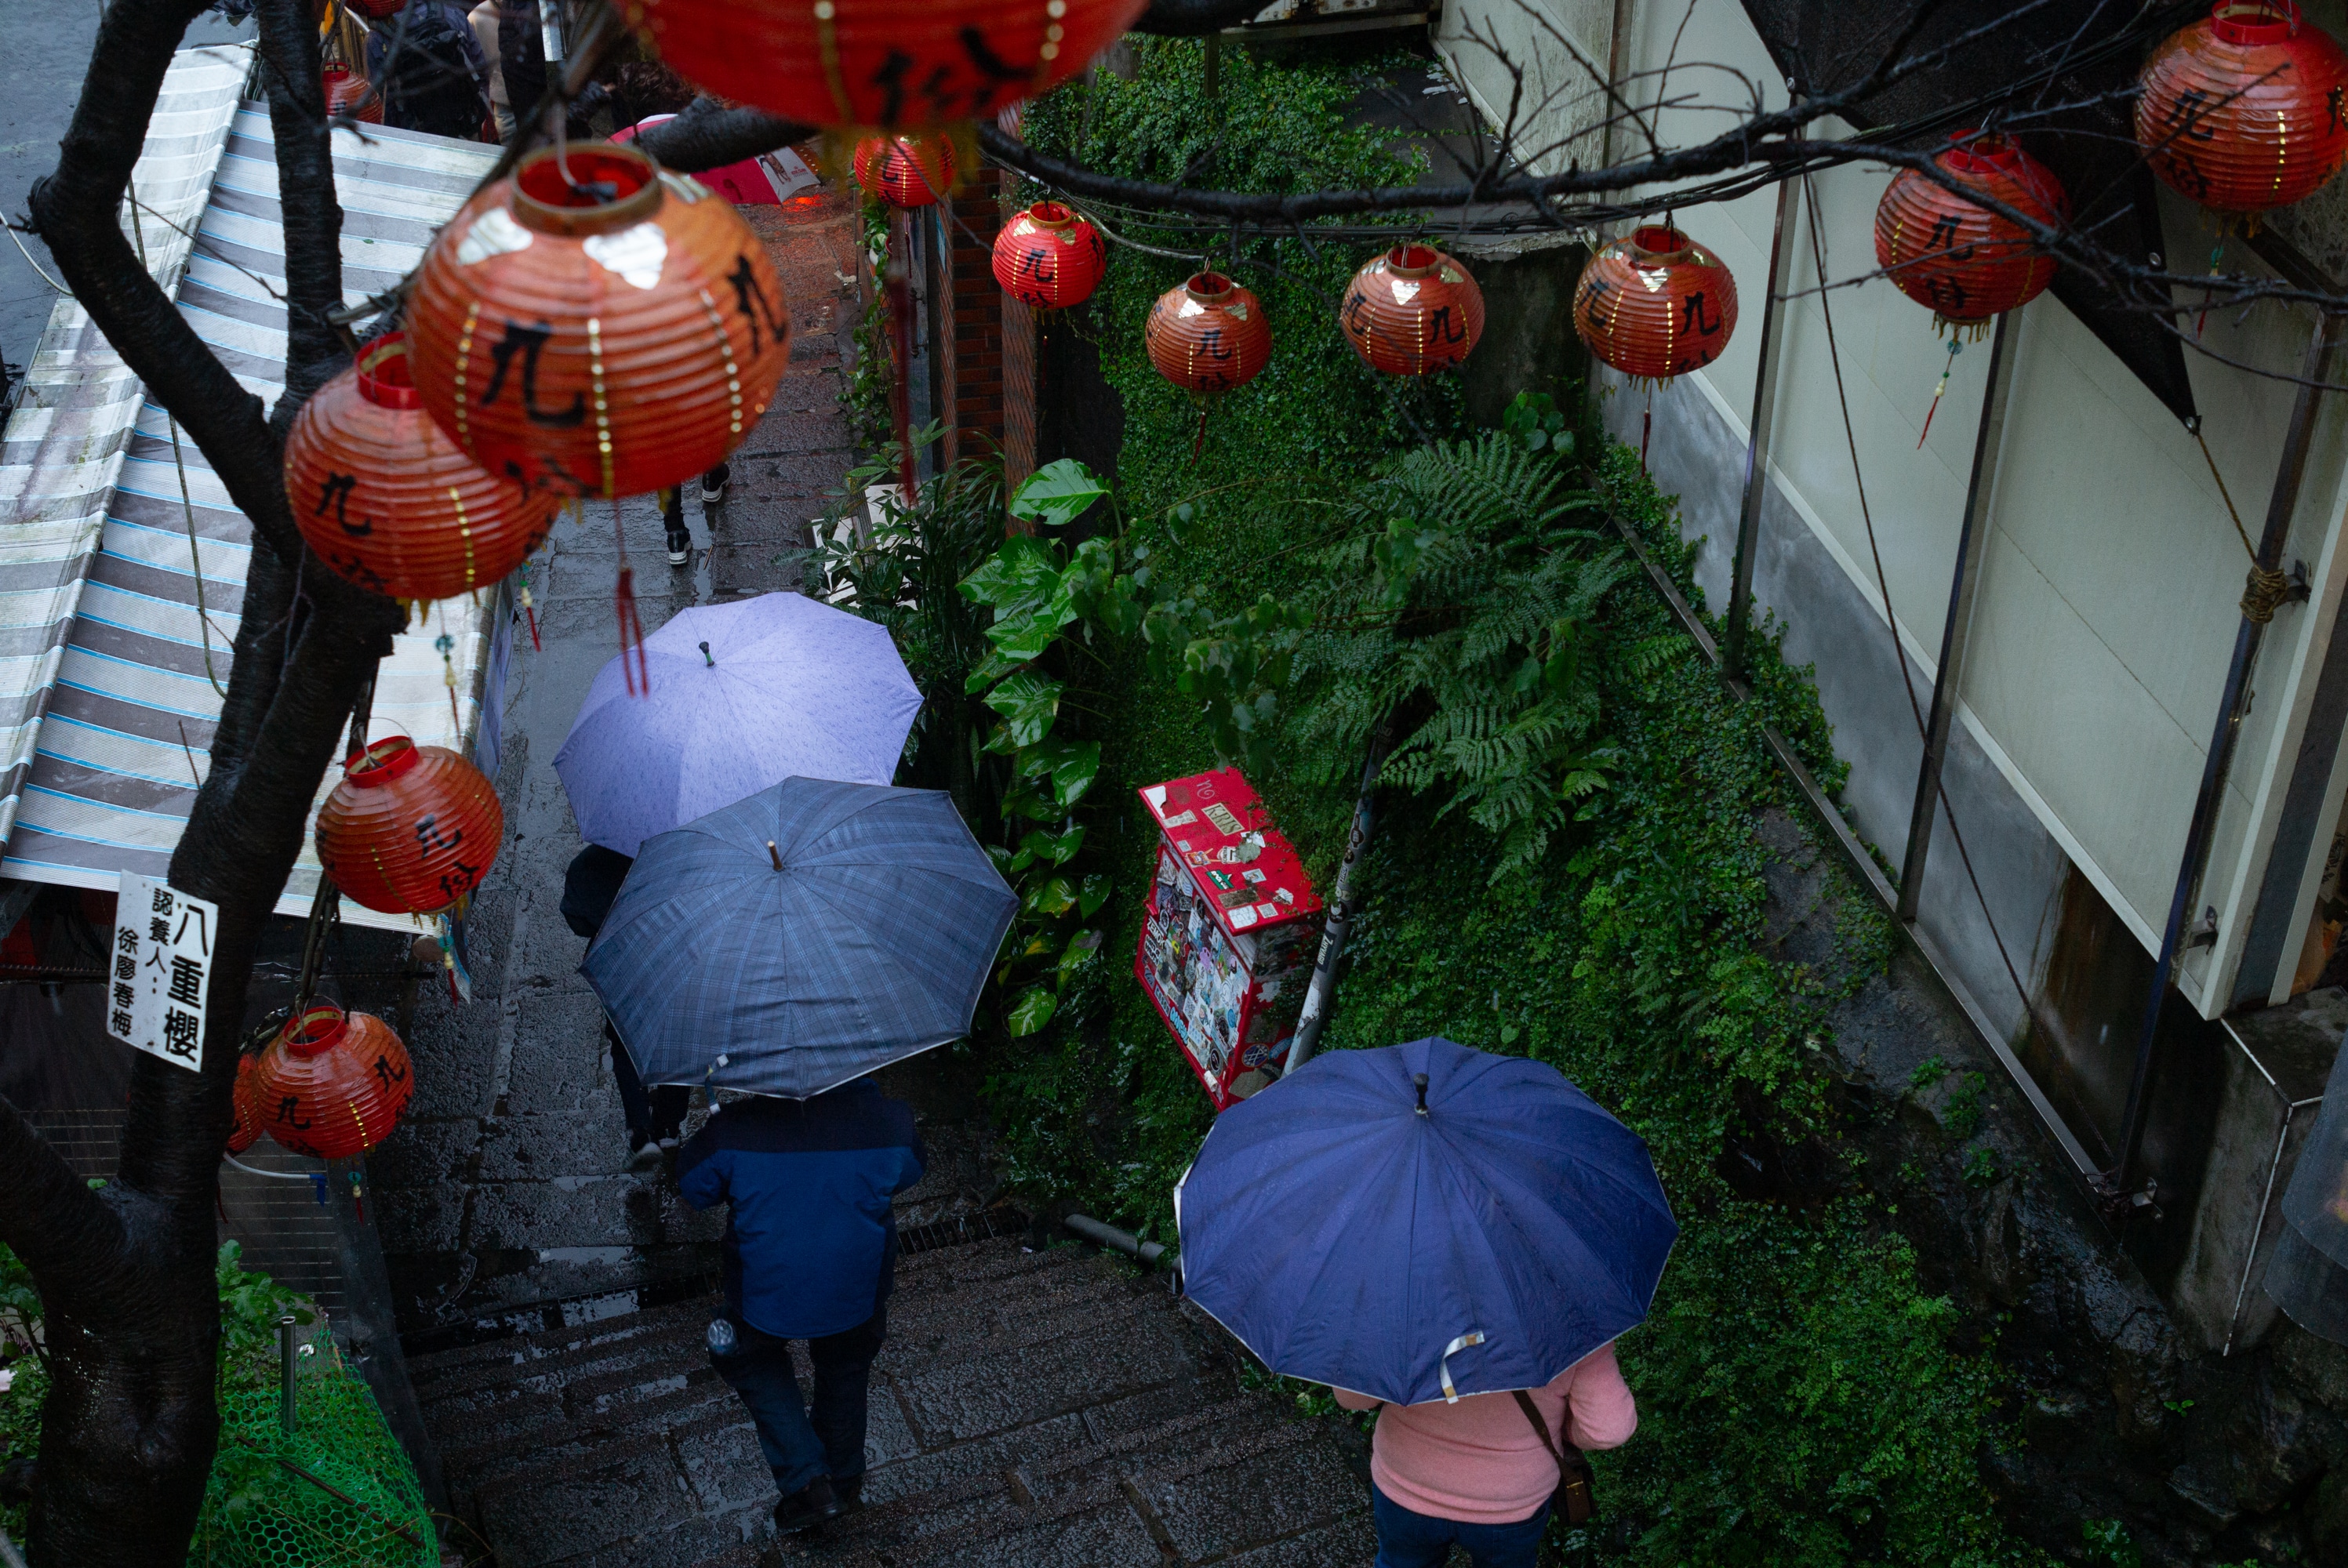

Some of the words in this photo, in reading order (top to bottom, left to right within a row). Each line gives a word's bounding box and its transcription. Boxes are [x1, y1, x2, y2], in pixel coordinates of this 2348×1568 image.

[111, 926, 140, 1037] 徐廖春梅
[164, 903, 209, 1063] 八重櫻
